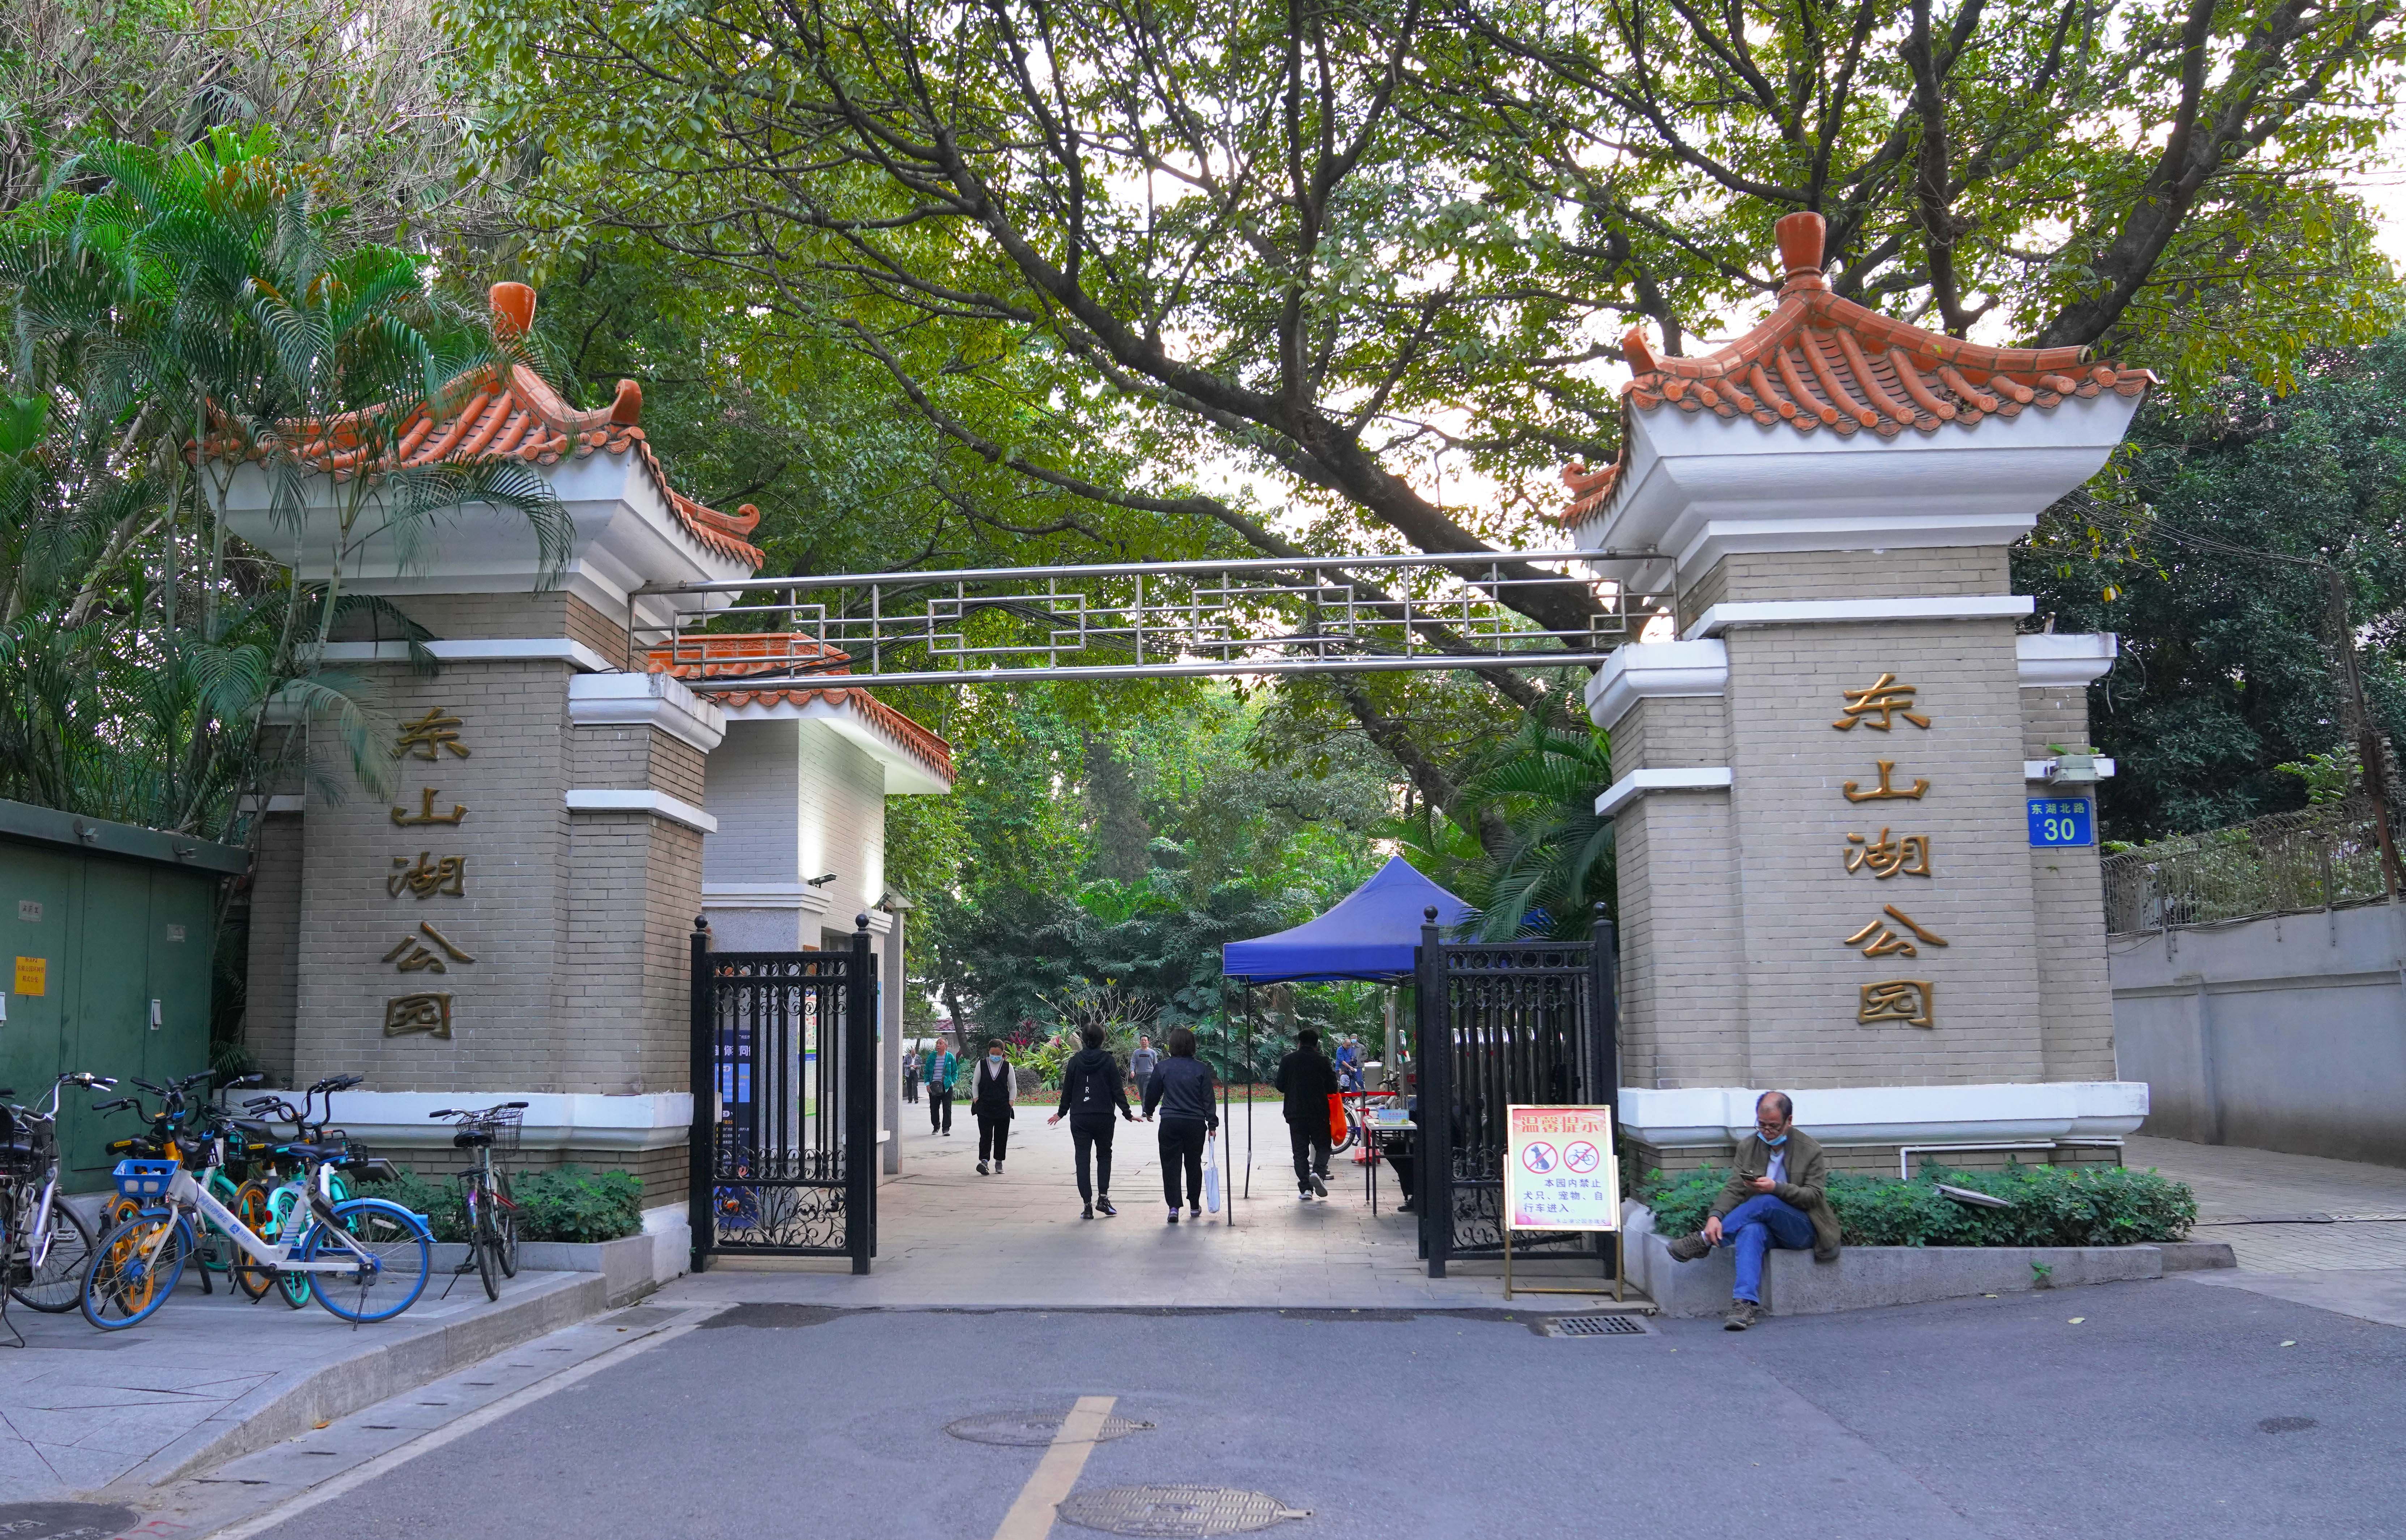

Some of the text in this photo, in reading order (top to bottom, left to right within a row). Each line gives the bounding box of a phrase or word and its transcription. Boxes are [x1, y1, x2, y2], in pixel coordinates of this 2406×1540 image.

[2031, 803, 2085, 814] 东湖北路
[2044, 818, 2075, 841] 30
[1833, 673, 1948, 1028] 东山湖公园
[383, 706, 476, 1040] 东山湖公园
[1521, 1115, 1599, 1133] 温馨提示
[1544, 1178, 1602, 1188] 本园内禁止
